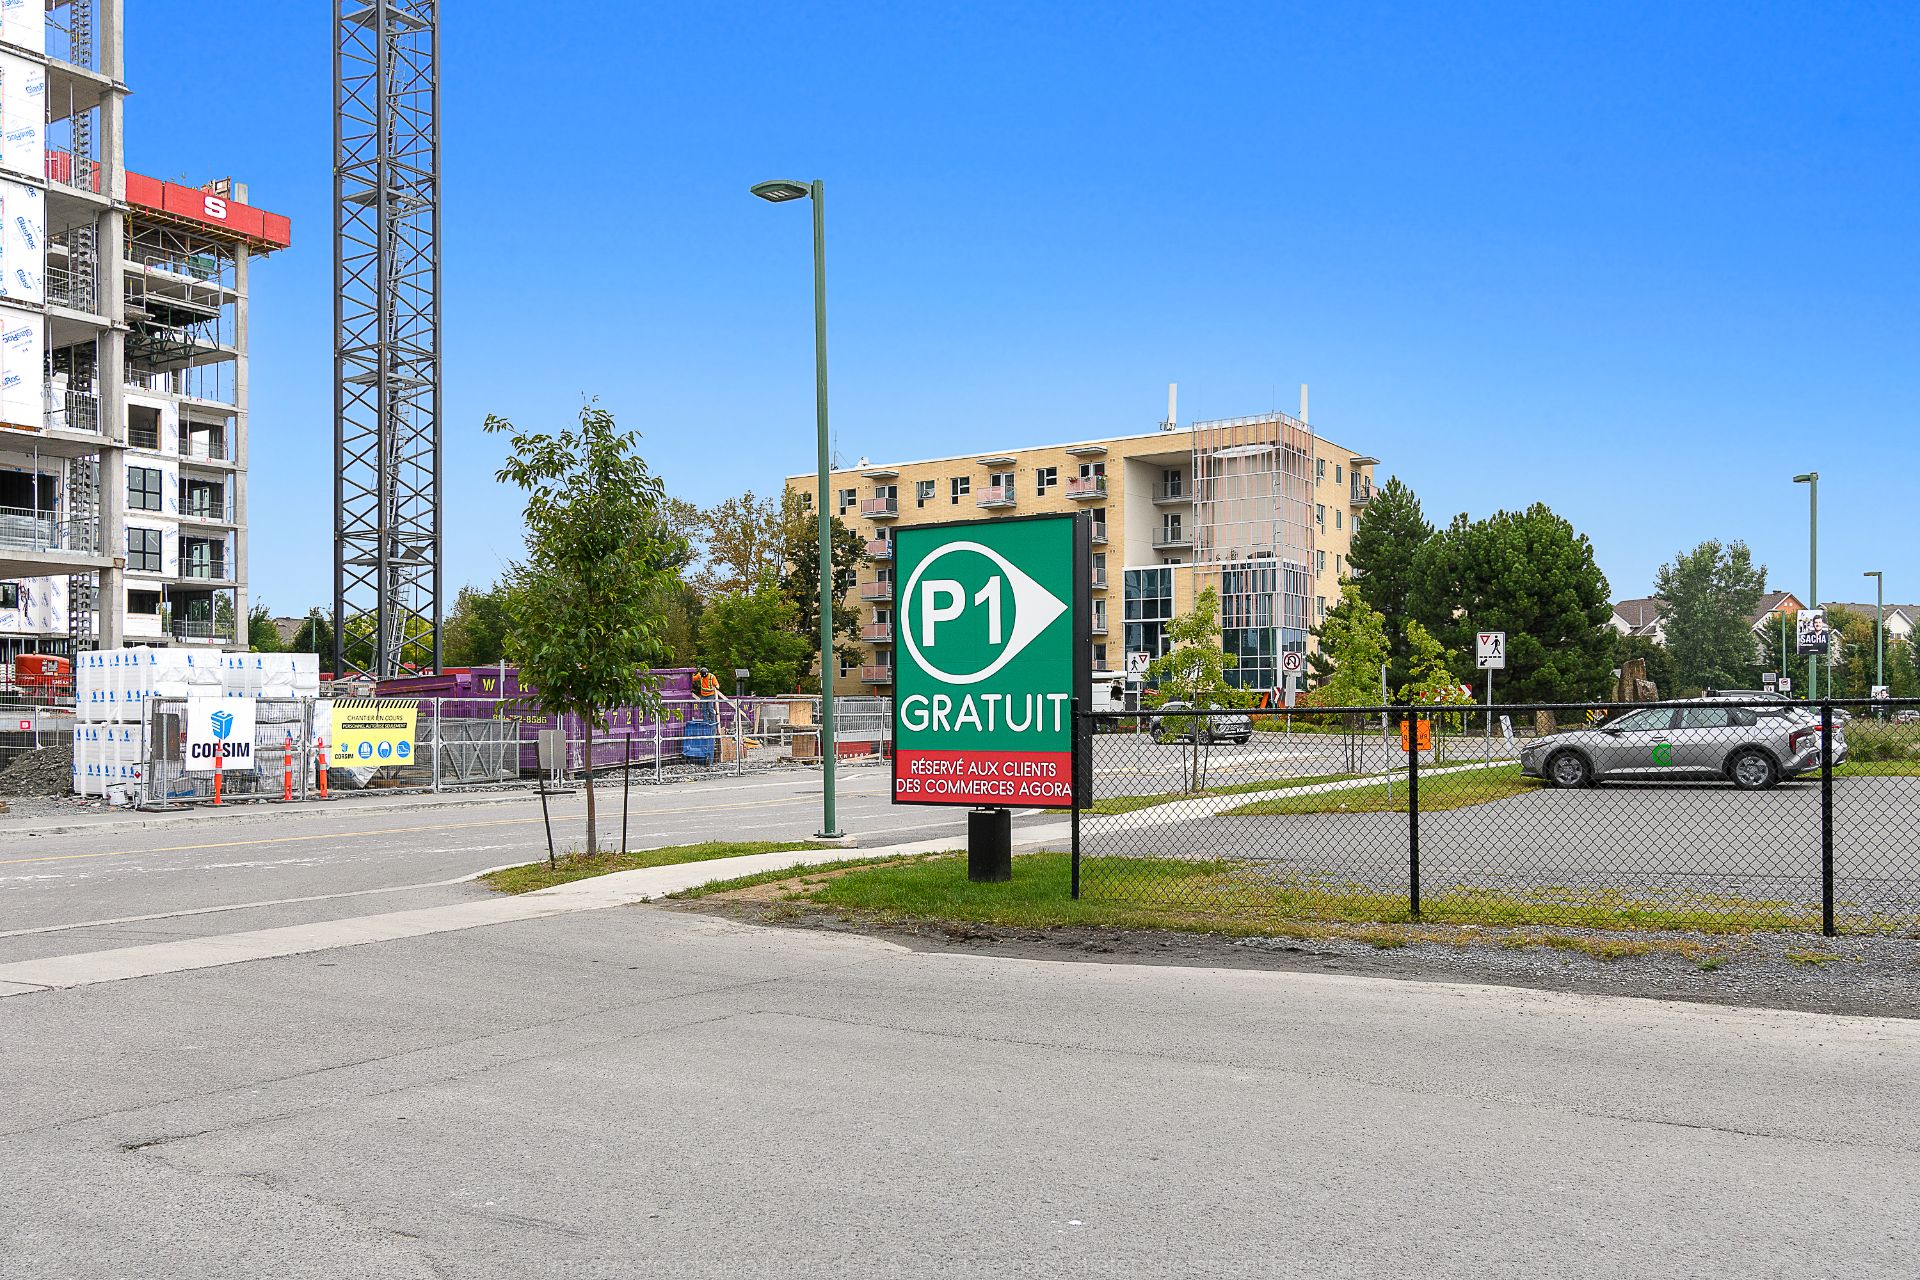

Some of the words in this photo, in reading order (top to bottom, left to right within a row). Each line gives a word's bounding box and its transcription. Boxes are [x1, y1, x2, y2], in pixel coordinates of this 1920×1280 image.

[16, 268, 32, 290] Glas
[921, 575, 1002, 647] P1
[1800, 634, 1827, 644] SACHA
[900, 693, 1069, 733] GRATUIT
[911, 758, 964, 775] RÉSERVÉ
[967, 761, 999, 776] AUX
[1002, 761, 1057, 777] CLIENTS
[896, 778, 921, 793] DES
[925, 779, 1015, 796] COMMERCES
[1018, 781, 1072, 797] AGORA
